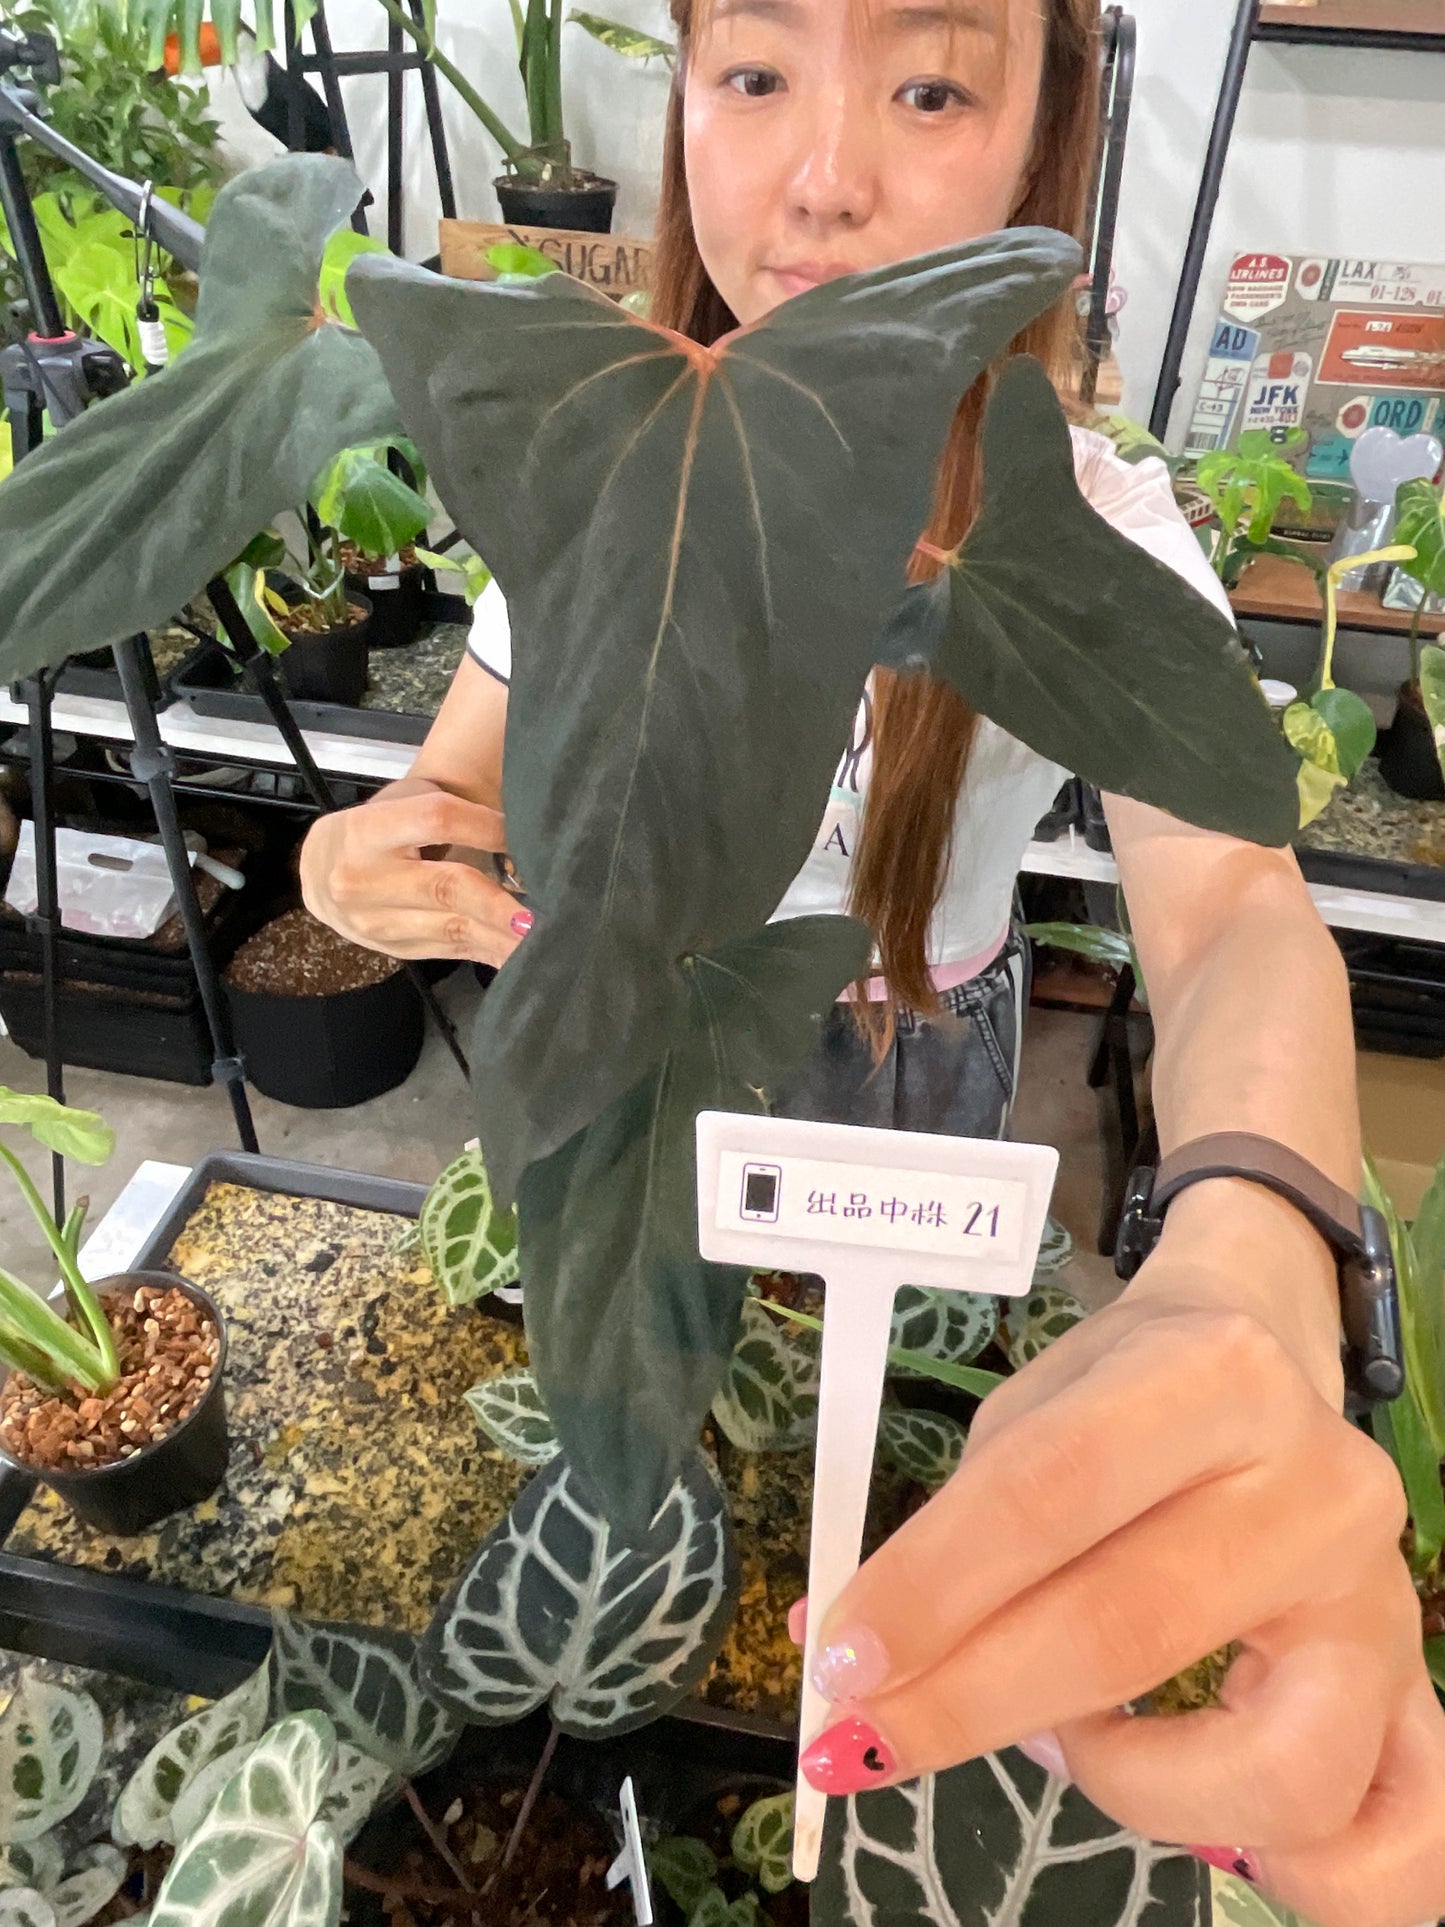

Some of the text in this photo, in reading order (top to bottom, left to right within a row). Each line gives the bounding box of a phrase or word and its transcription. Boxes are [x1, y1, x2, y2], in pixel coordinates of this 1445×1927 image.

[1341, 260, 1377, 279] LAX
[1253, 385, 1300, 405] JFK
[1374, 399, 1422, 428] ORD
[806, 1189, 1001, 1239] 出品中株 21
